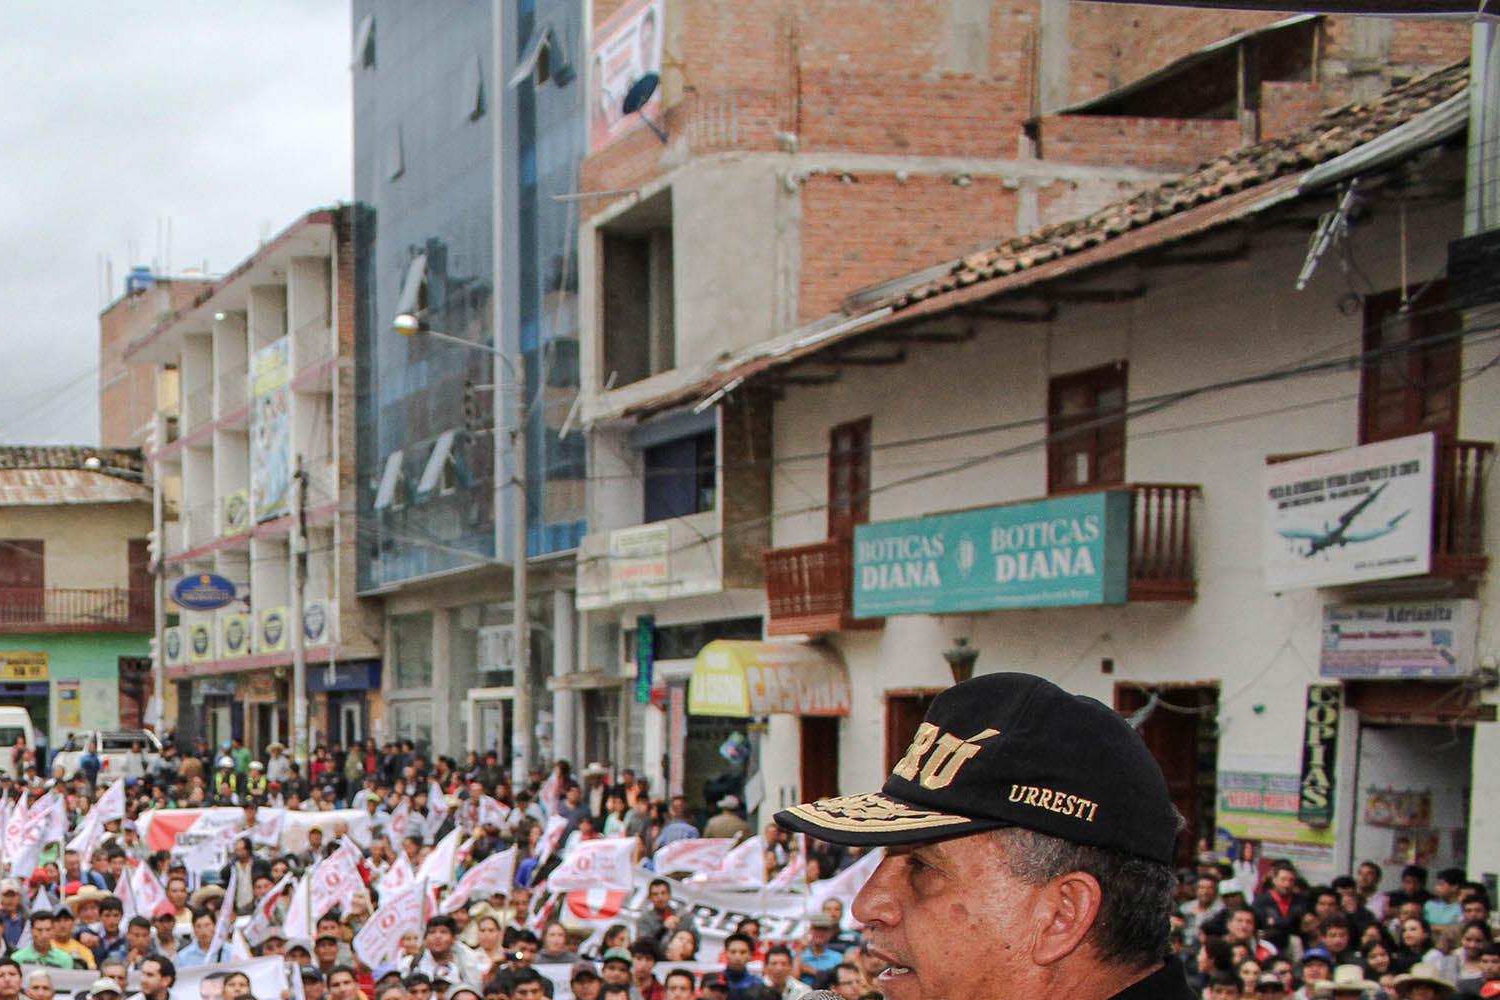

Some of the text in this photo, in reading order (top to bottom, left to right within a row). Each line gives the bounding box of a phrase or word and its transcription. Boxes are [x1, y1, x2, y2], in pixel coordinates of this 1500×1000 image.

[857, 533, 945, 563] BOTICAS
[991, 514, 1099, 552] BOTICAS
[861, 560, 942, 591] DIANA
[995, 546, 1095, 582] DIANA
[892, 721, 1000, 790] RÚ
[1301, 684, 1340, 810] COPIAS
[1008, 784, 1098, 822] URRESTI
